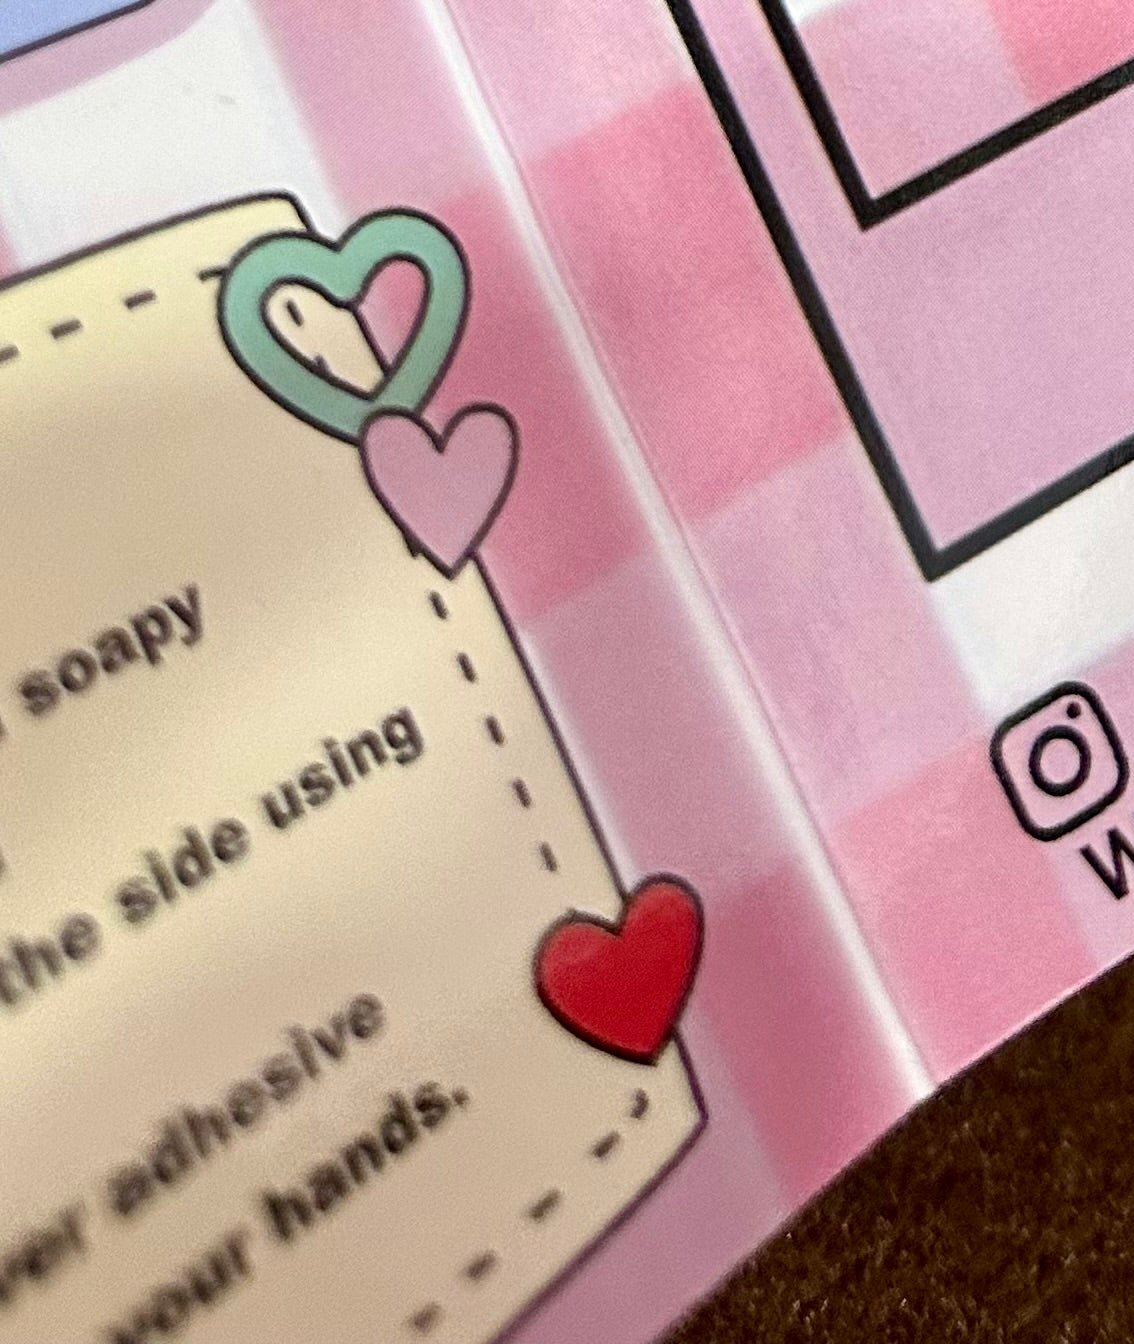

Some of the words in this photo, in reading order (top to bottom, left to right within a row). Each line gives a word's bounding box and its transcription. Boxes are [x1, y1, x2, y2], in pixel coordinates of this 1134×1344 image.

[17, 585, 204, 717] soapy
[116, 821, 251, 925] side
[261, 707, 425, 830] using
[106, 992, 384, 1217] adhesive
[261, 1081, 470, 1243] hands.
